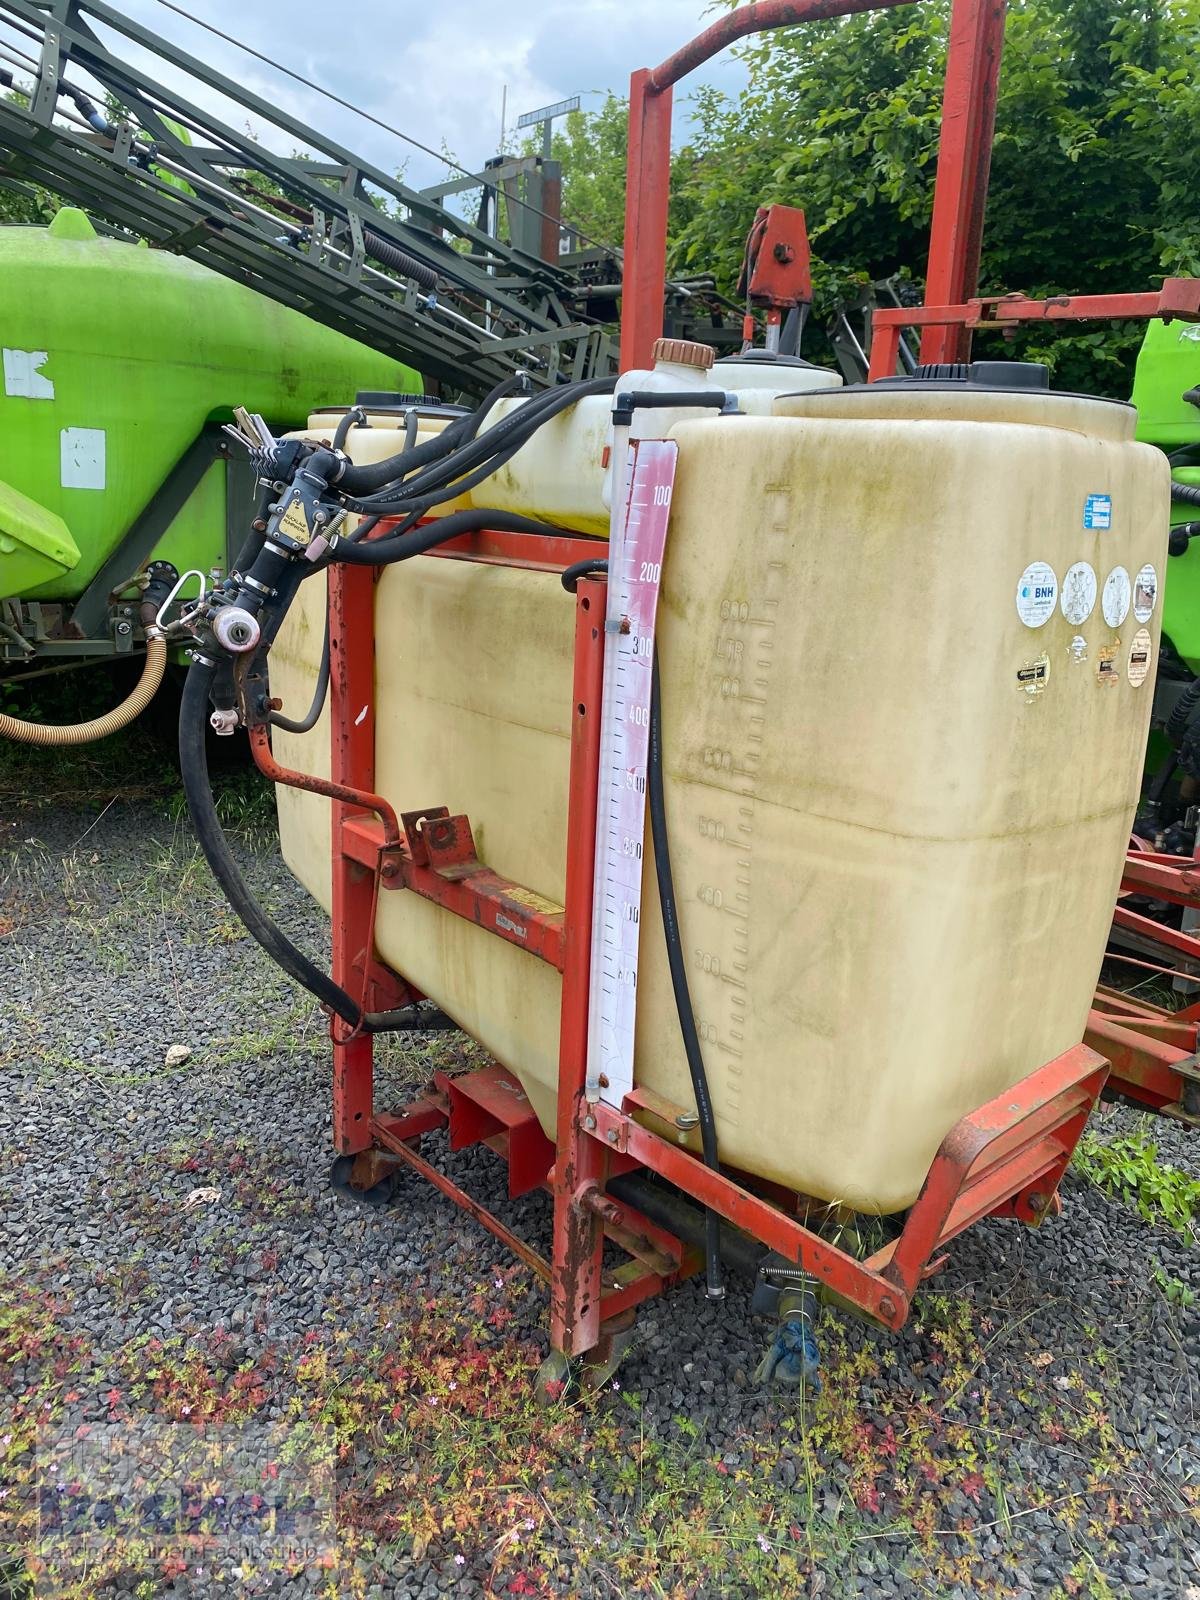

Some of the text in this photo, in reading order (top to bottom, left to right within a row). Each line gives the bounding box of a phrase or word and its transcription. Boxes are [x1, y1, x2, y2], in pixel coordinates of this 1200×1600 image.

[654, 485, 671, 507] 100
[640, 562, 661, 584] 200
[1035, 586, 1054, 598] BNH
[632, 636, 652, 658] 300
